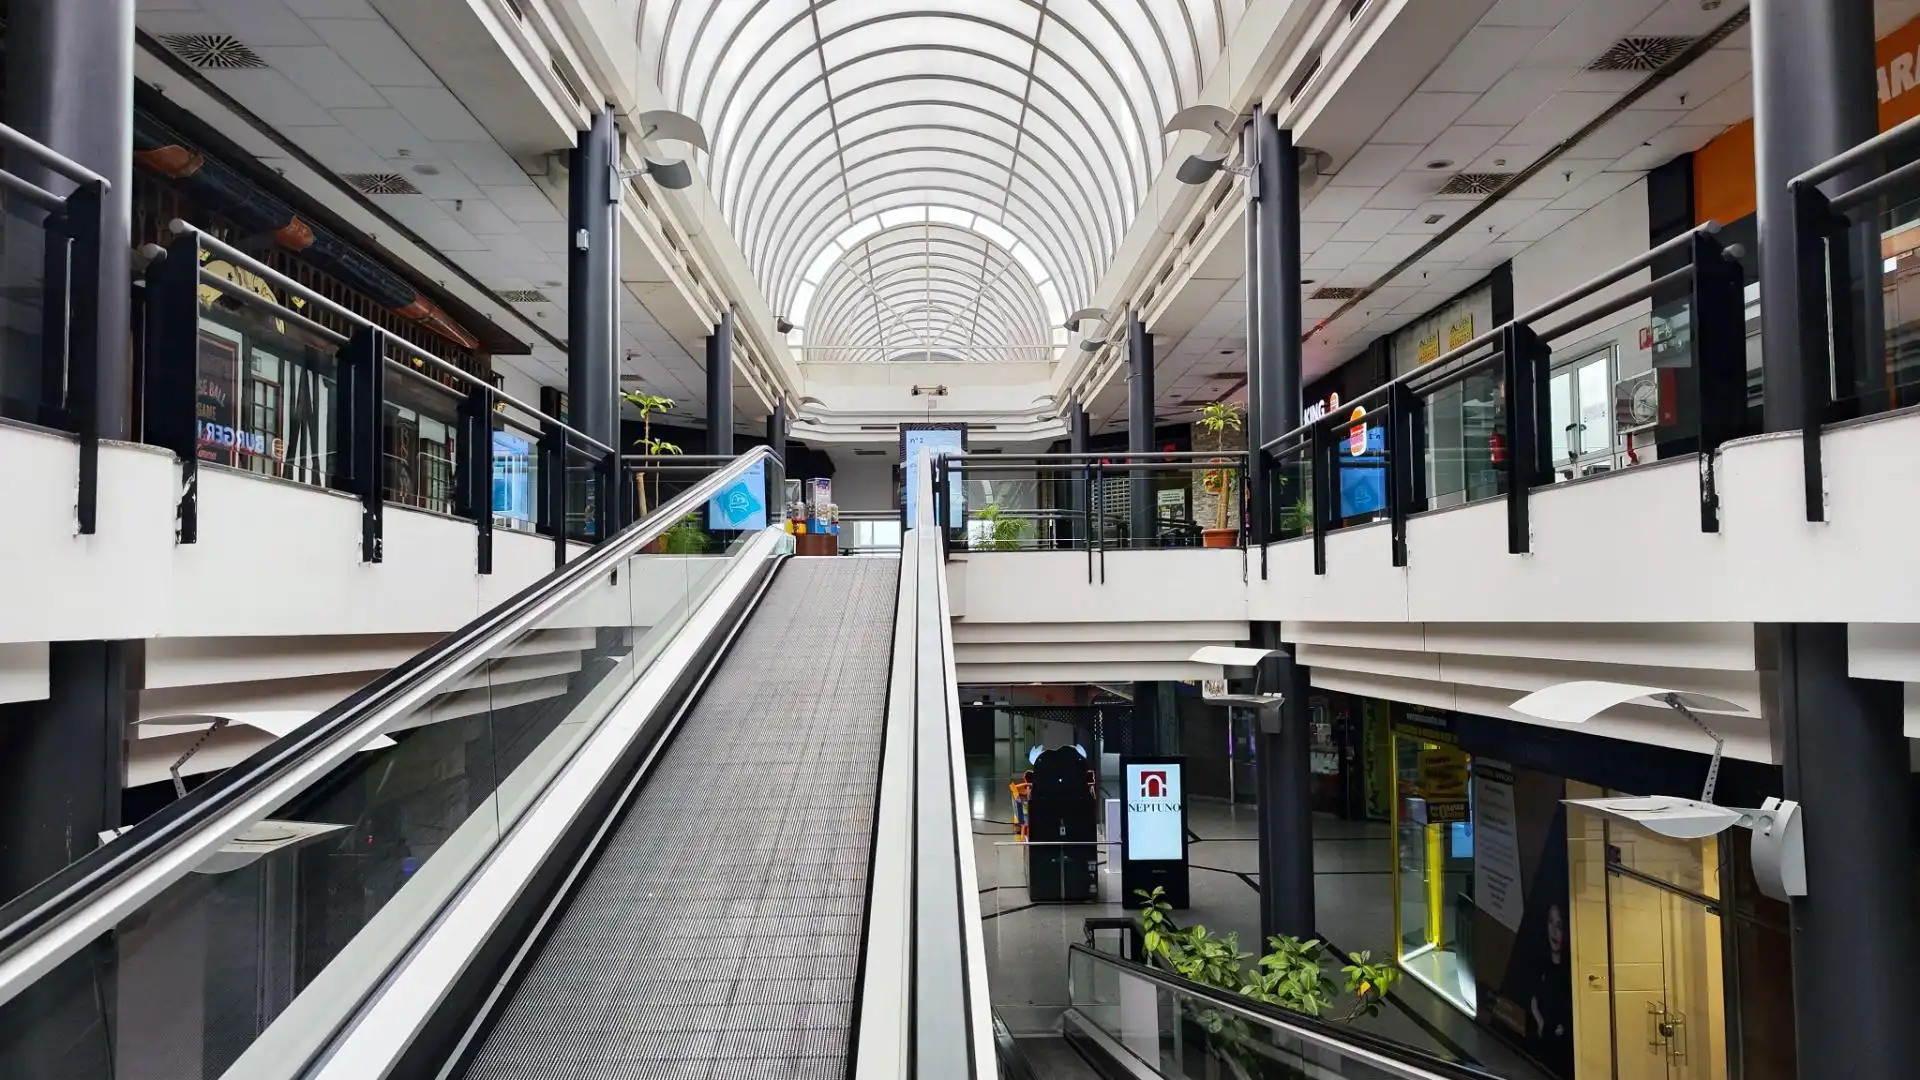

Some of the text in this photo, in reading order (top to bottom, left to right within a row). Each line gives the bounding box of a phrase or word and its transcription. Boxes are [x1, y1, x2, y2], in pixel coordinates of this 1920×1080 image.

[1877, 44, 1920, 104] AR
[209, 381, 226, 408] BALL
[1304, 399, 1325, 426] KING
[1129, 803, 1181, 812] NEPTUNO
